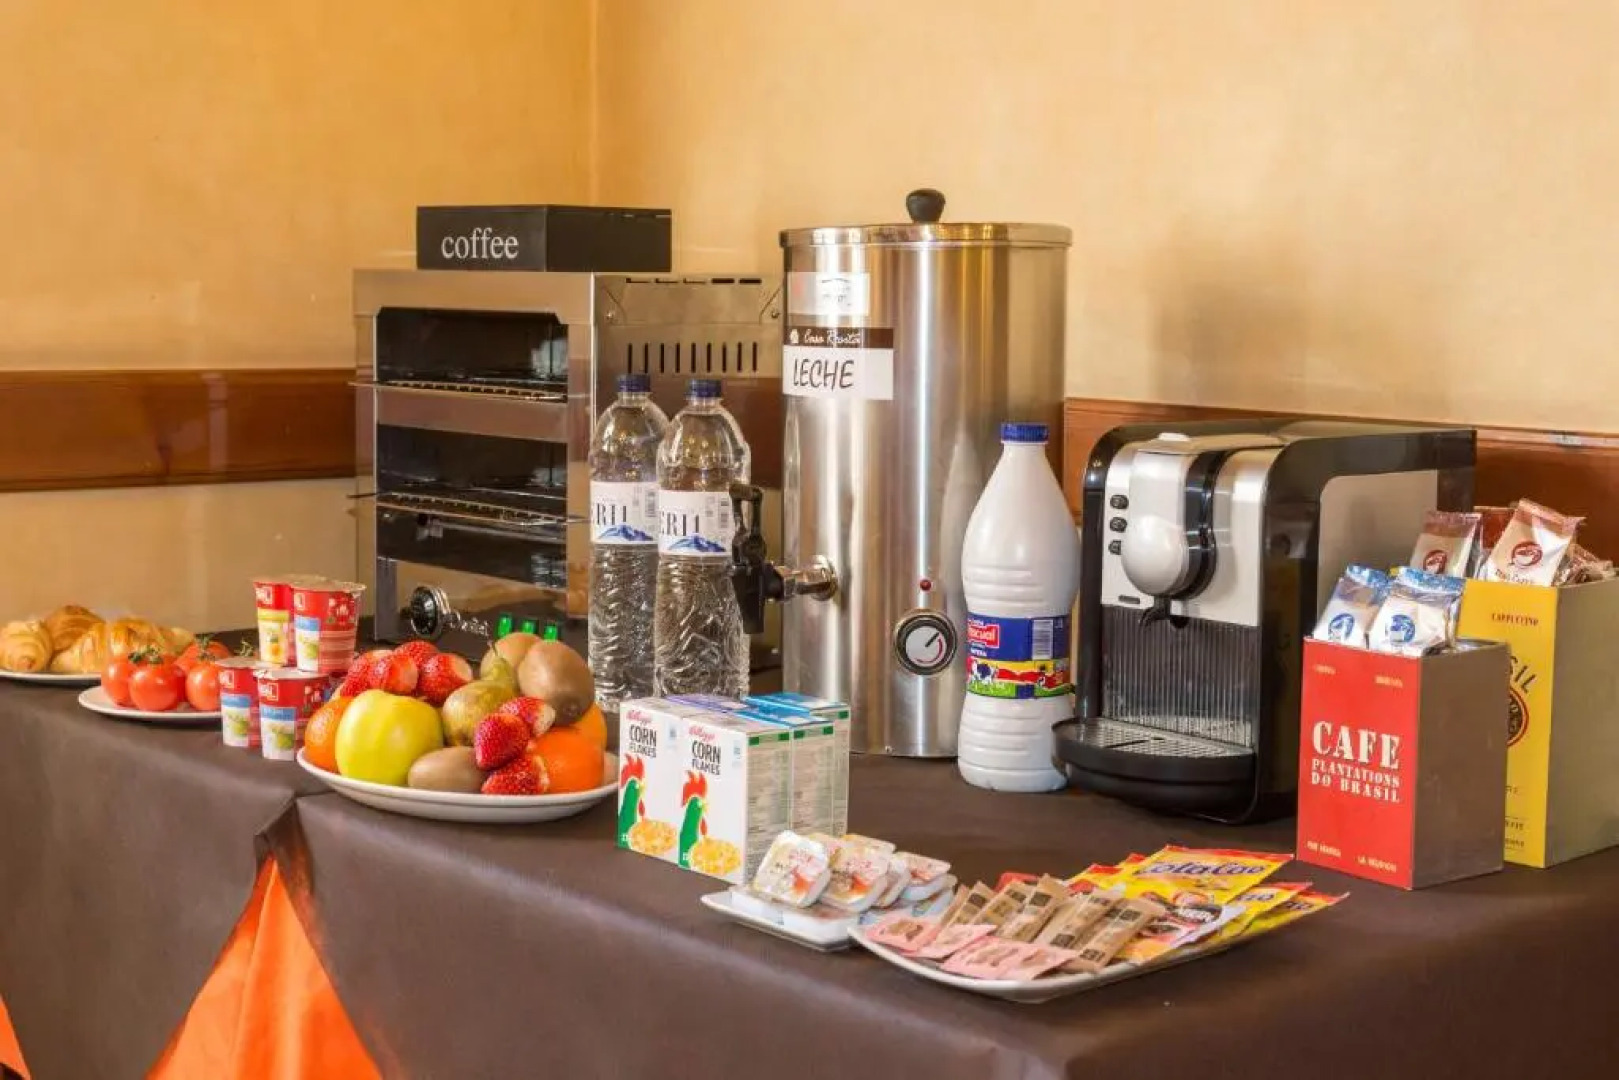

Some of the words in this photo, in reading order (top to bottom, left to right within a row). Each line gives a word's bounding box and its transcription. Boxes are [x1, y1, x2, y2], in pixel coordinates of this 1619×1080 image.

[440, 227, 519, 259] coffee
[793, 358, 855, 390] LECHE
[629, 725, 658, 748] CORN
[629, 742, 658, 758] FLAKES
[691, 739, 722, 765] CORN
[1312, 720, 1401, 771] CAFE
[691, 758, 721, 776] FLAKES
[1311, 758, 1400, 789] PLANTATIONS
[1311, 771, 1332, 787] DO
[1340, 777, 1400, 803] BRASIL
